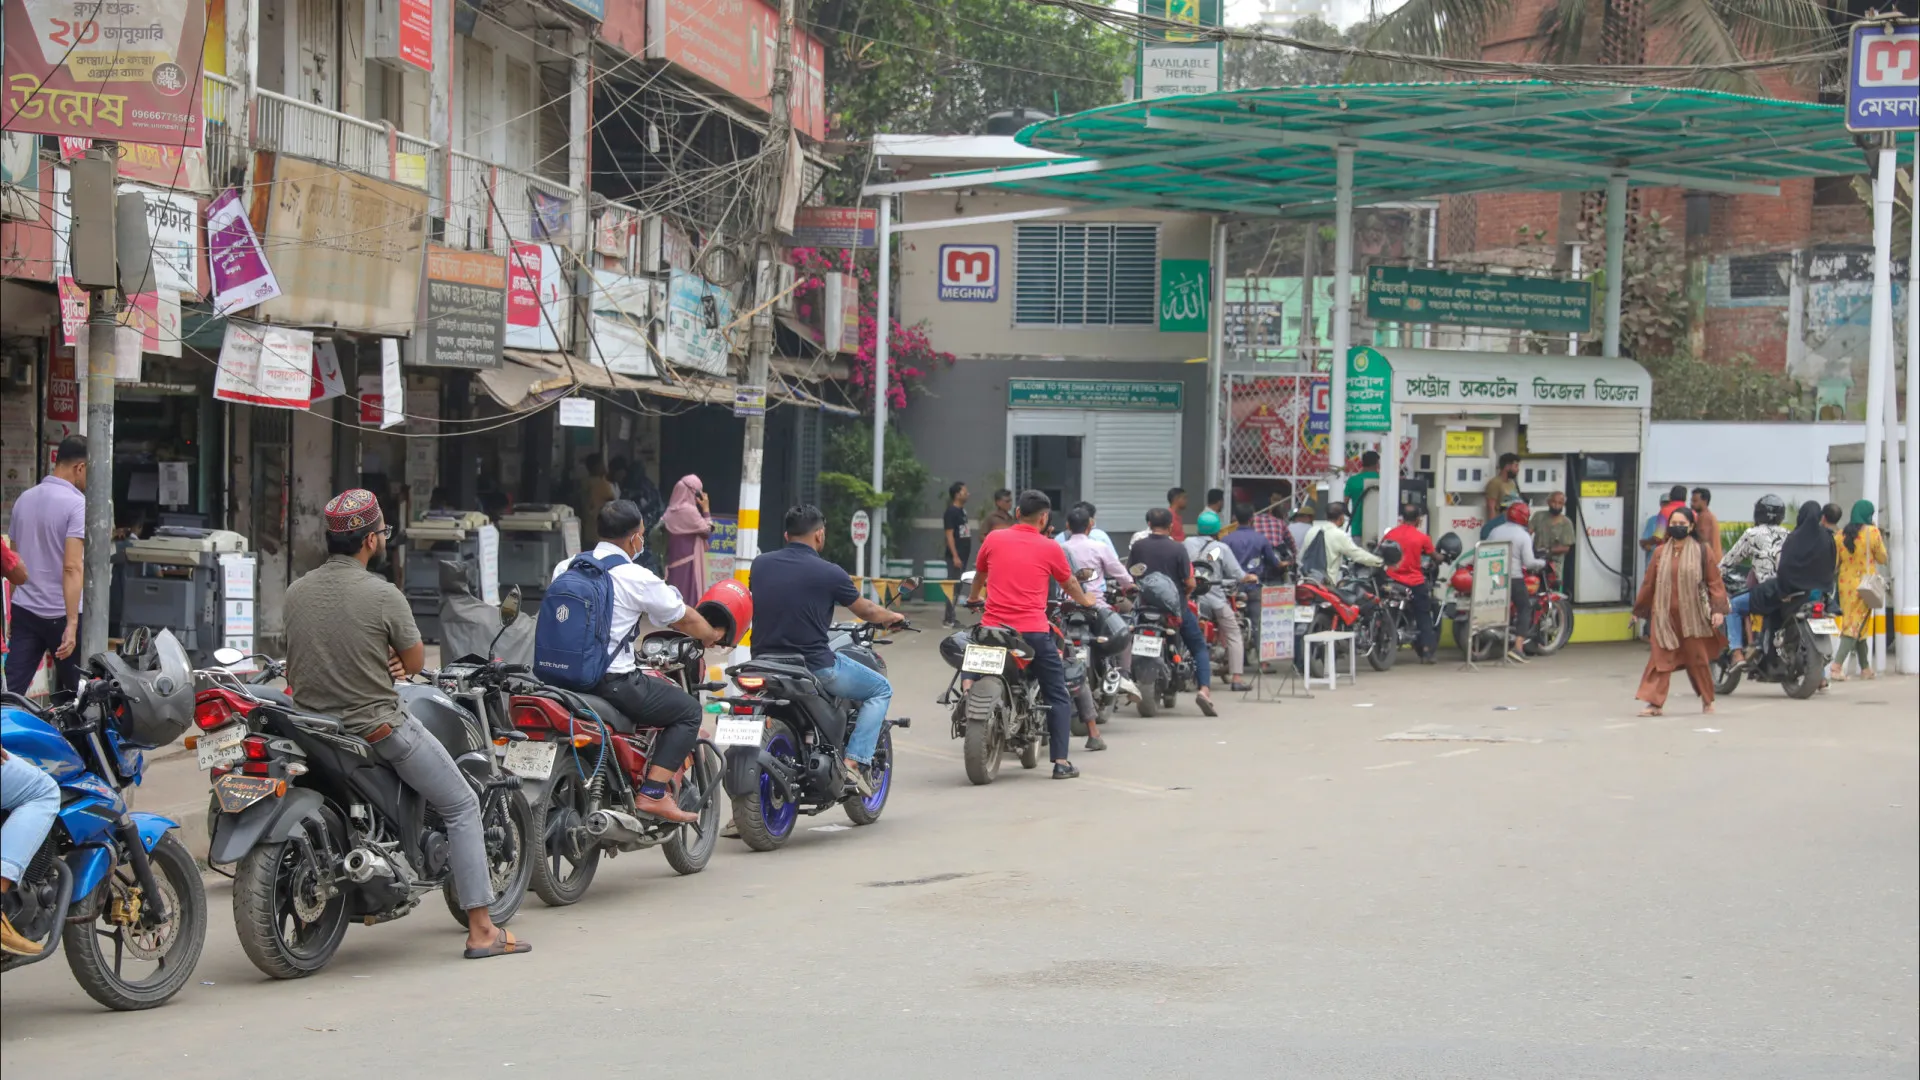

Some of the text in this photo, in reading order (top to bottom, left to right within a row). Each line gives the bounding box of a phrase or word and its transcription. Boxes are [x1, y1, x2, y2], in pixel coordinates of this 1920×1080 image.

[104, 23, 164, 44] জানুয়ারি
[1150, 58, 1211, 69] AVAILABLE
[1165, 69, 1194, 79] HERE
[9, 73, 128, 128] উন্মেষ
[941, 287, 994, 300] MEGHNA
[1012, 382, 1045, 390] WELCOME
[1047, 382, 1056, 390] TO
[1159, 385, 1178, 393] PUMP
[1406, 374, 1640, 401] পেট্রোল অকটেন ডিজেল ডিজেল
